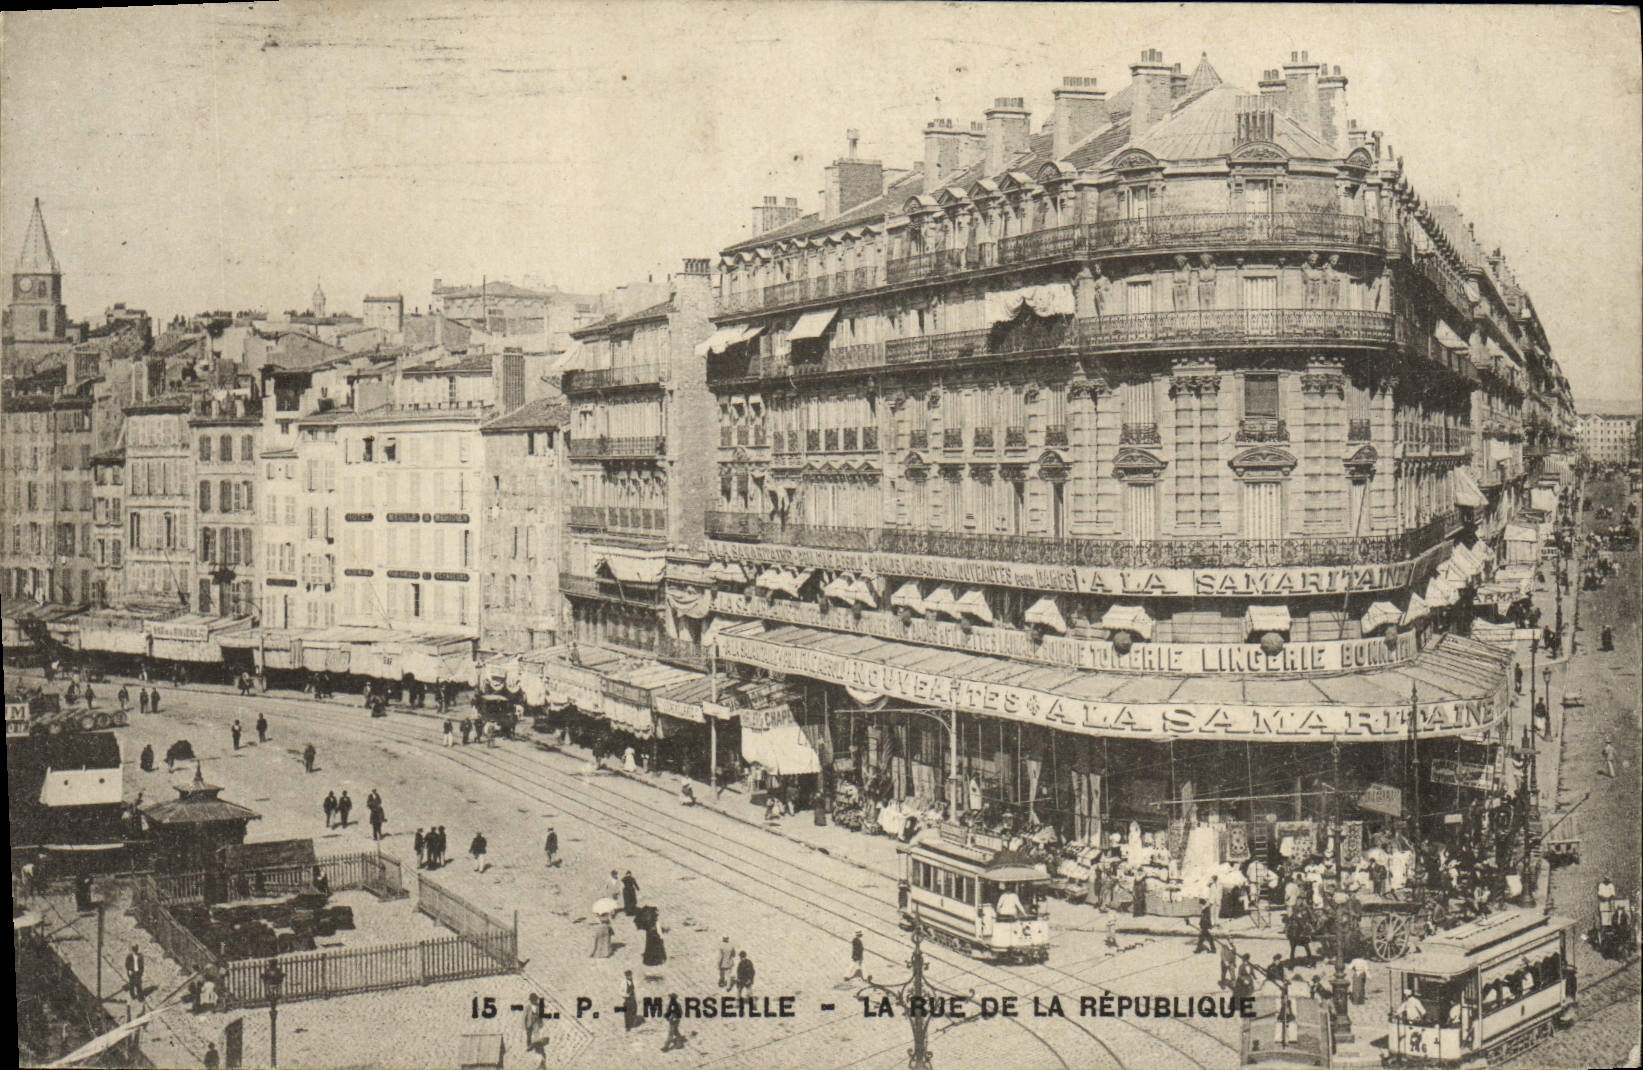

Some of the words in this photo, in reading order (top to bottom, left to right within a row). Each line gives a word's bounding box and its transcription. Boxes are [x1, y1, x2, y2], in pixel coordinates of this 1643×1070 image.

[1090, 571, 1112, 592] A
[1120, 572, 1179, 594] LA
[1202, 647, 1326, 672] LINGERIE
[1046, 698, 1075, 725] A
[1083, 703, 1152, 731] LA
[1162, 701, 1496, 735] SAMARITAINE
